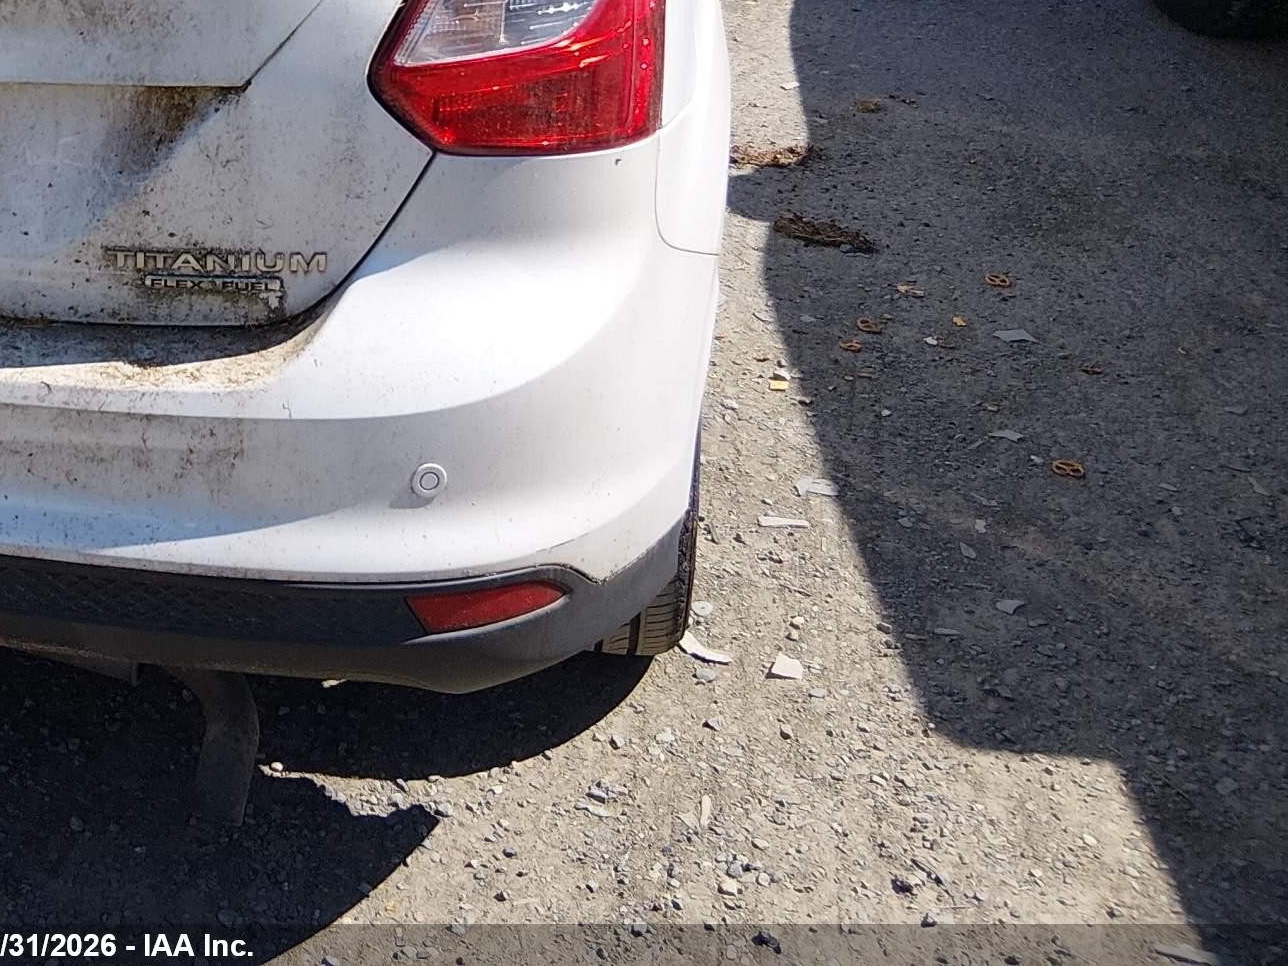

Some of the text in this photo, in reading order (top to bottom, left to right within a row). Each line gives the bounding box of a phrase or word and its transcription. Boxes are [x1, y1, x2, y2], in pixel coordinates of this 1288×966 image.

[106, 250, 328, 273] TITANIUM
[148, 278, 272, 292] FLEX FUEL
